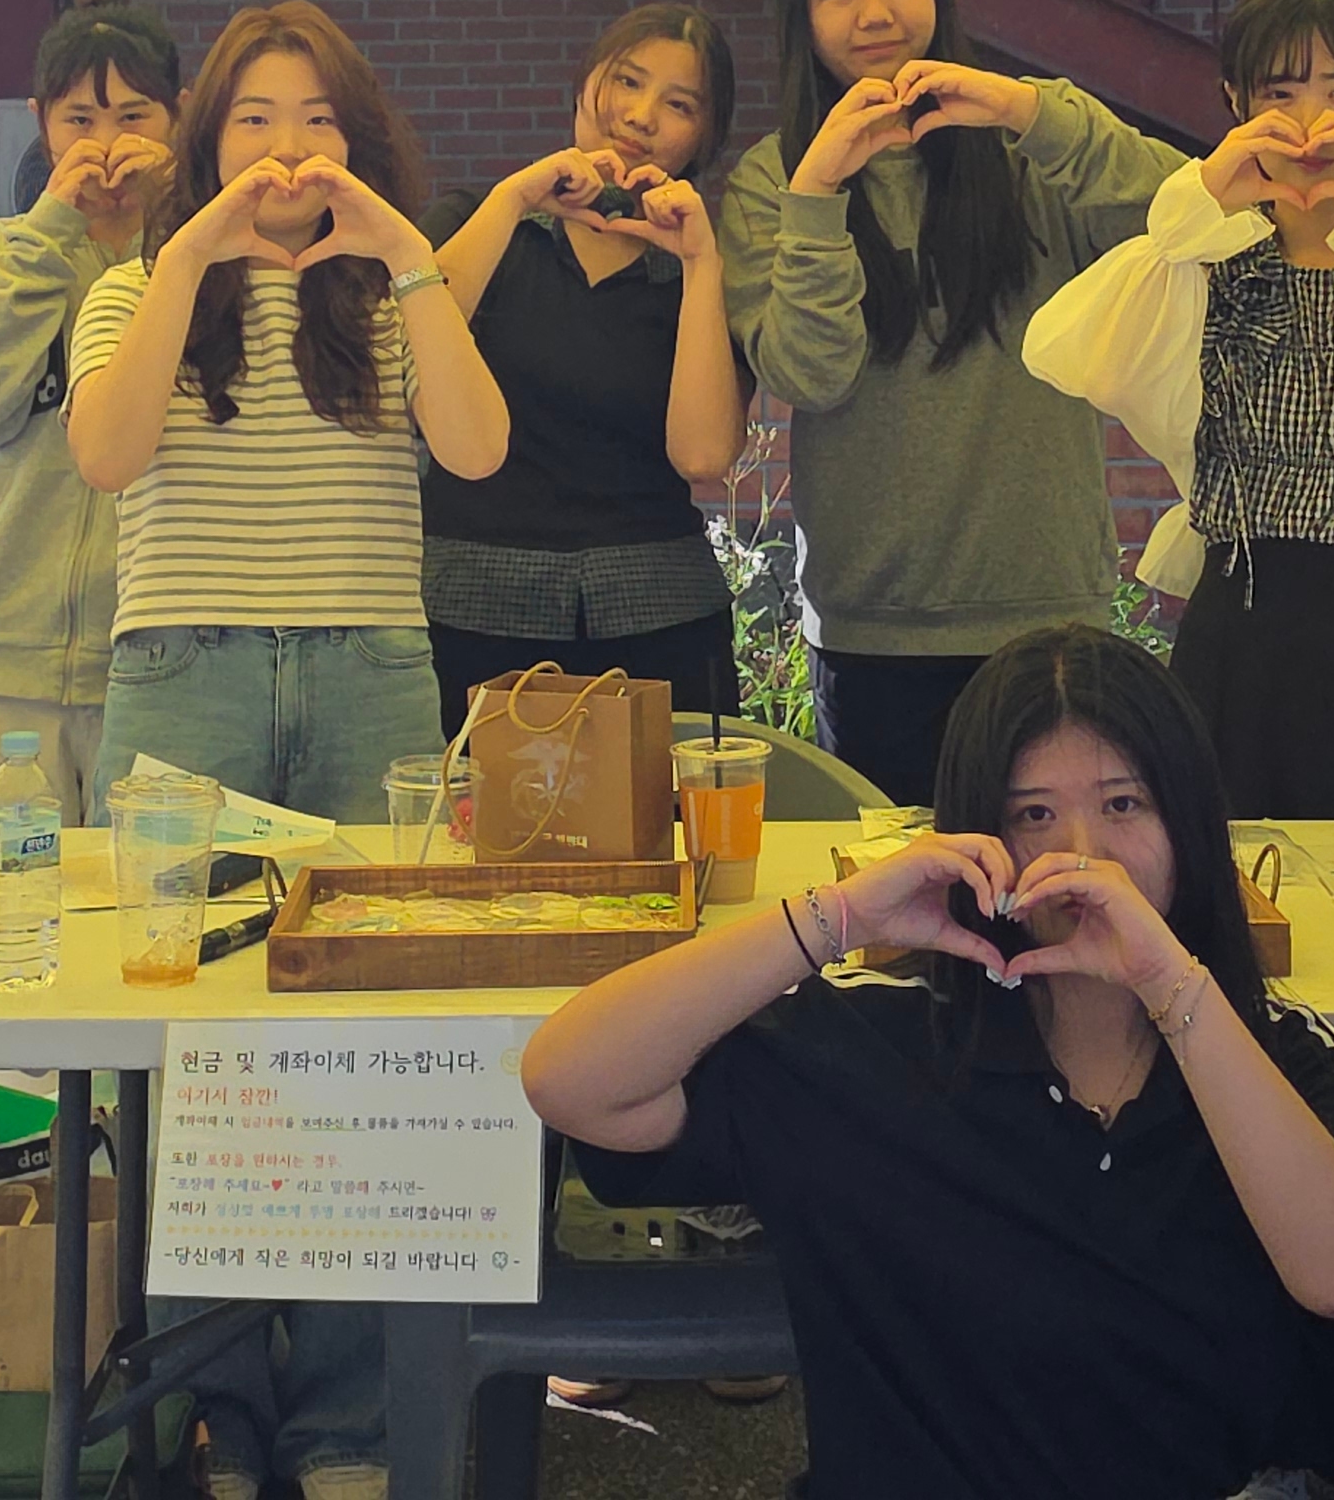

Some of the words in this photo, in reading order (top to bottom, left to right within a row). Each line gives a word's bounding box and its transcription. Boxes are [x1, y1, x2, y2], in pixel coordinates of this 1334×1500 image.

[180, 1050, 224, 1075] 현금
[236, 1050, 256, 1075] 및
[268, 1050, 357, 1075] 계좌이체
[367, 1050, 486, 1075] 가능합니다.
[224, 1115, 235, 1129] 시
[454, 1118, 467, 1131] 수
[171, 1152, 198, 1168] 또한
[296, 1179, 324, 1194] 라고
[254, 1249, 291, 1268] 작은
[299, 1250, 353, 1270] 희망이
[362, 1250, 397, 1270] 되길
[407, 1251, 478, 1271] 바랍니다
